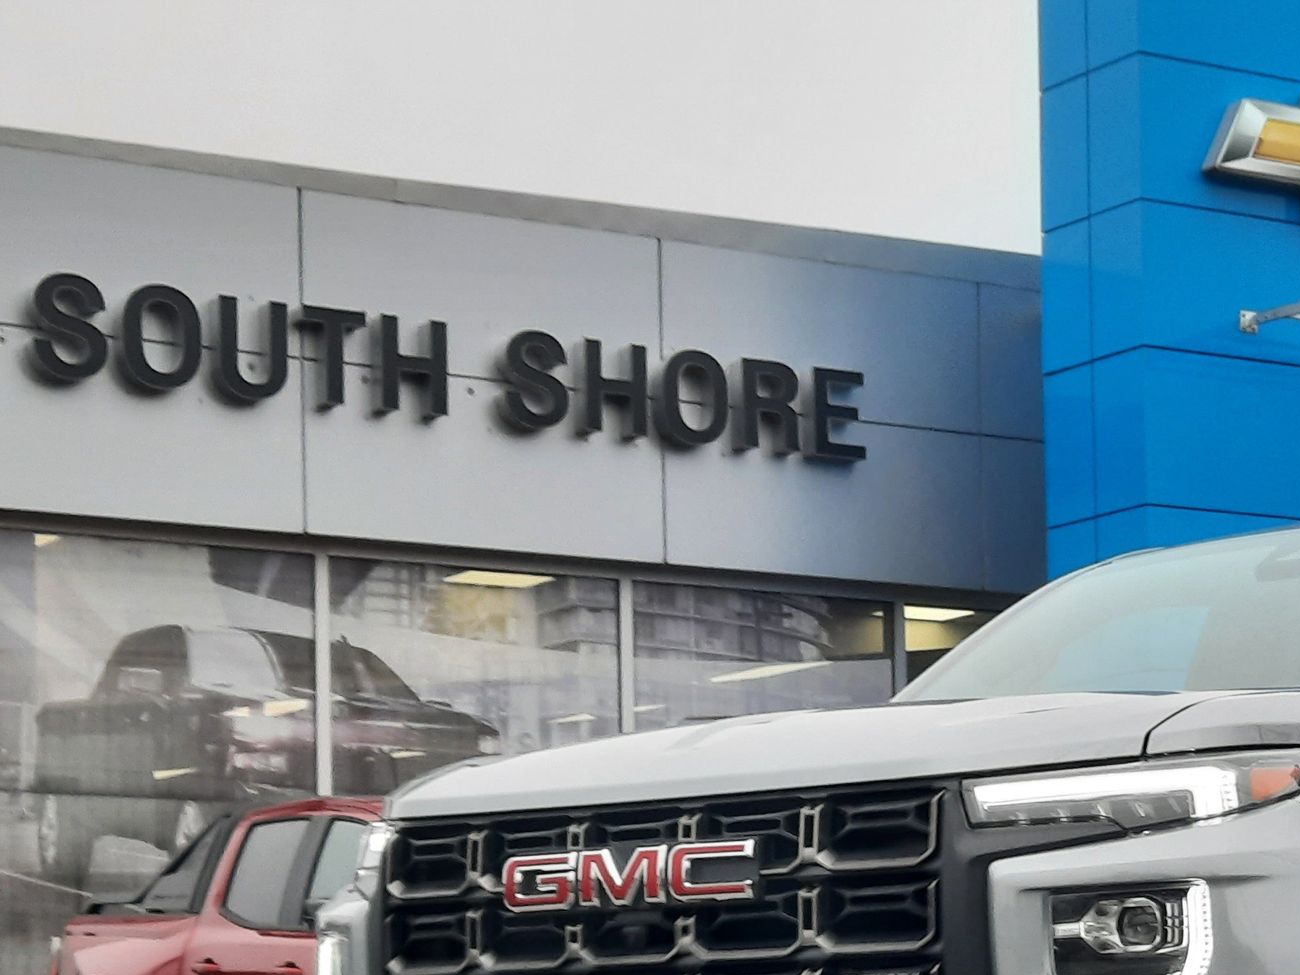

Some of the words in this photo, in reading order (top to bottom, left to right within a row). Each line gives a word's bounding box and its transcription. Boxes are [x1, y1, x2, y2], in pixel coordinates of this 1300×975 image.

[30, 271, 448, 420] SOUTH
[502, 329, 867, 462] SHORE
[502, 838, 758, 913] GMC
